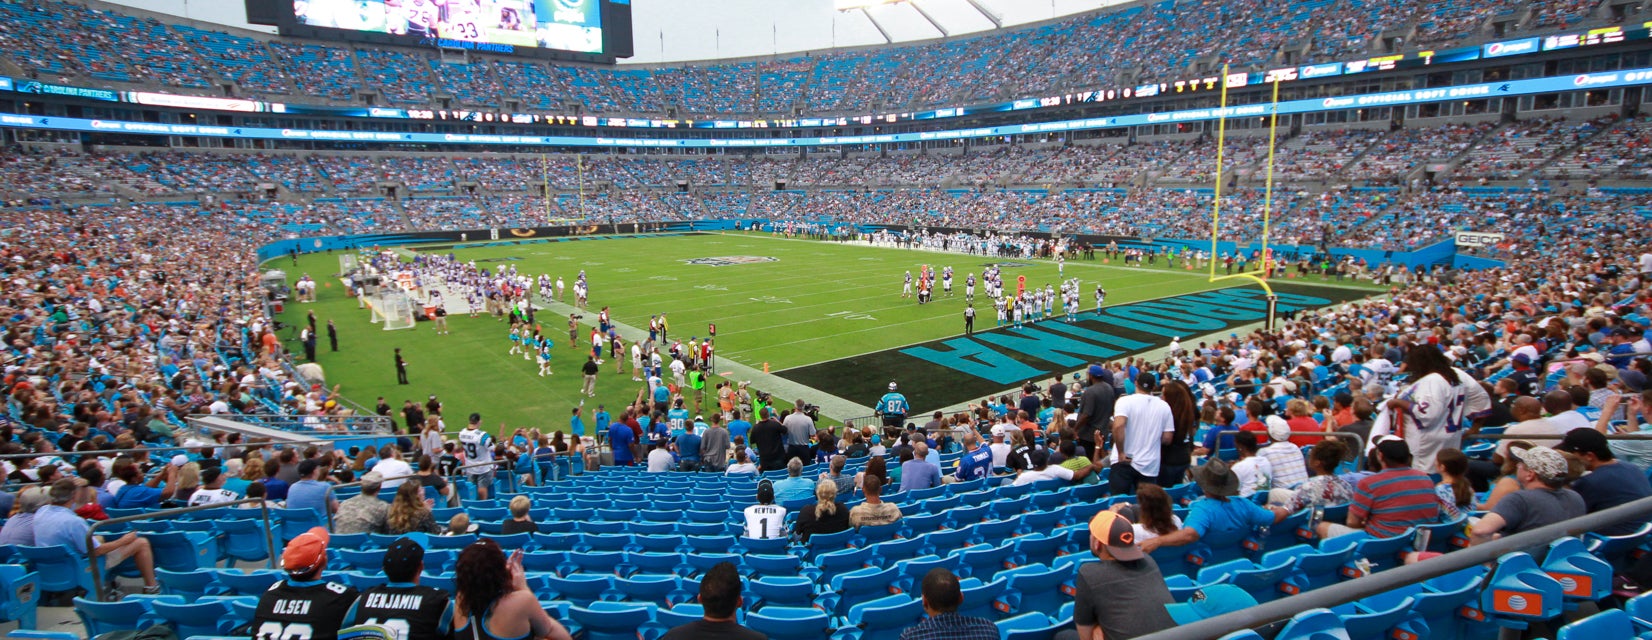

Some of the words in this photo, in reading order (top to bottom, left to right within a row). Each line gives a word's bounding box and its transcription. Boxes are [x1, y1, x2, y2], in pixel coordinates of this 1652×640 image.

[437, 38, 474, 50] CAROLINA
[476, 42, 514, 53] PANTHERS
[43, 84, 78, 96] CAROLINA
[79, 88, 112, 99] PANTHERS
[1358, 93, 1412, 105] OFFICIAL
[1415, 89, 1446, 100] SOFT
[1449, 85, 1490, 97] DRINK
[887, 400, 902, 412] 87
[670, 418, 684, 430] 90
[754, 507, 777, 515] NEWTON
[759, 518, 769, 540] 1
[272, 599, 312, 615] OLSEN
[365, 593, 423, 611] BENJAMIN
